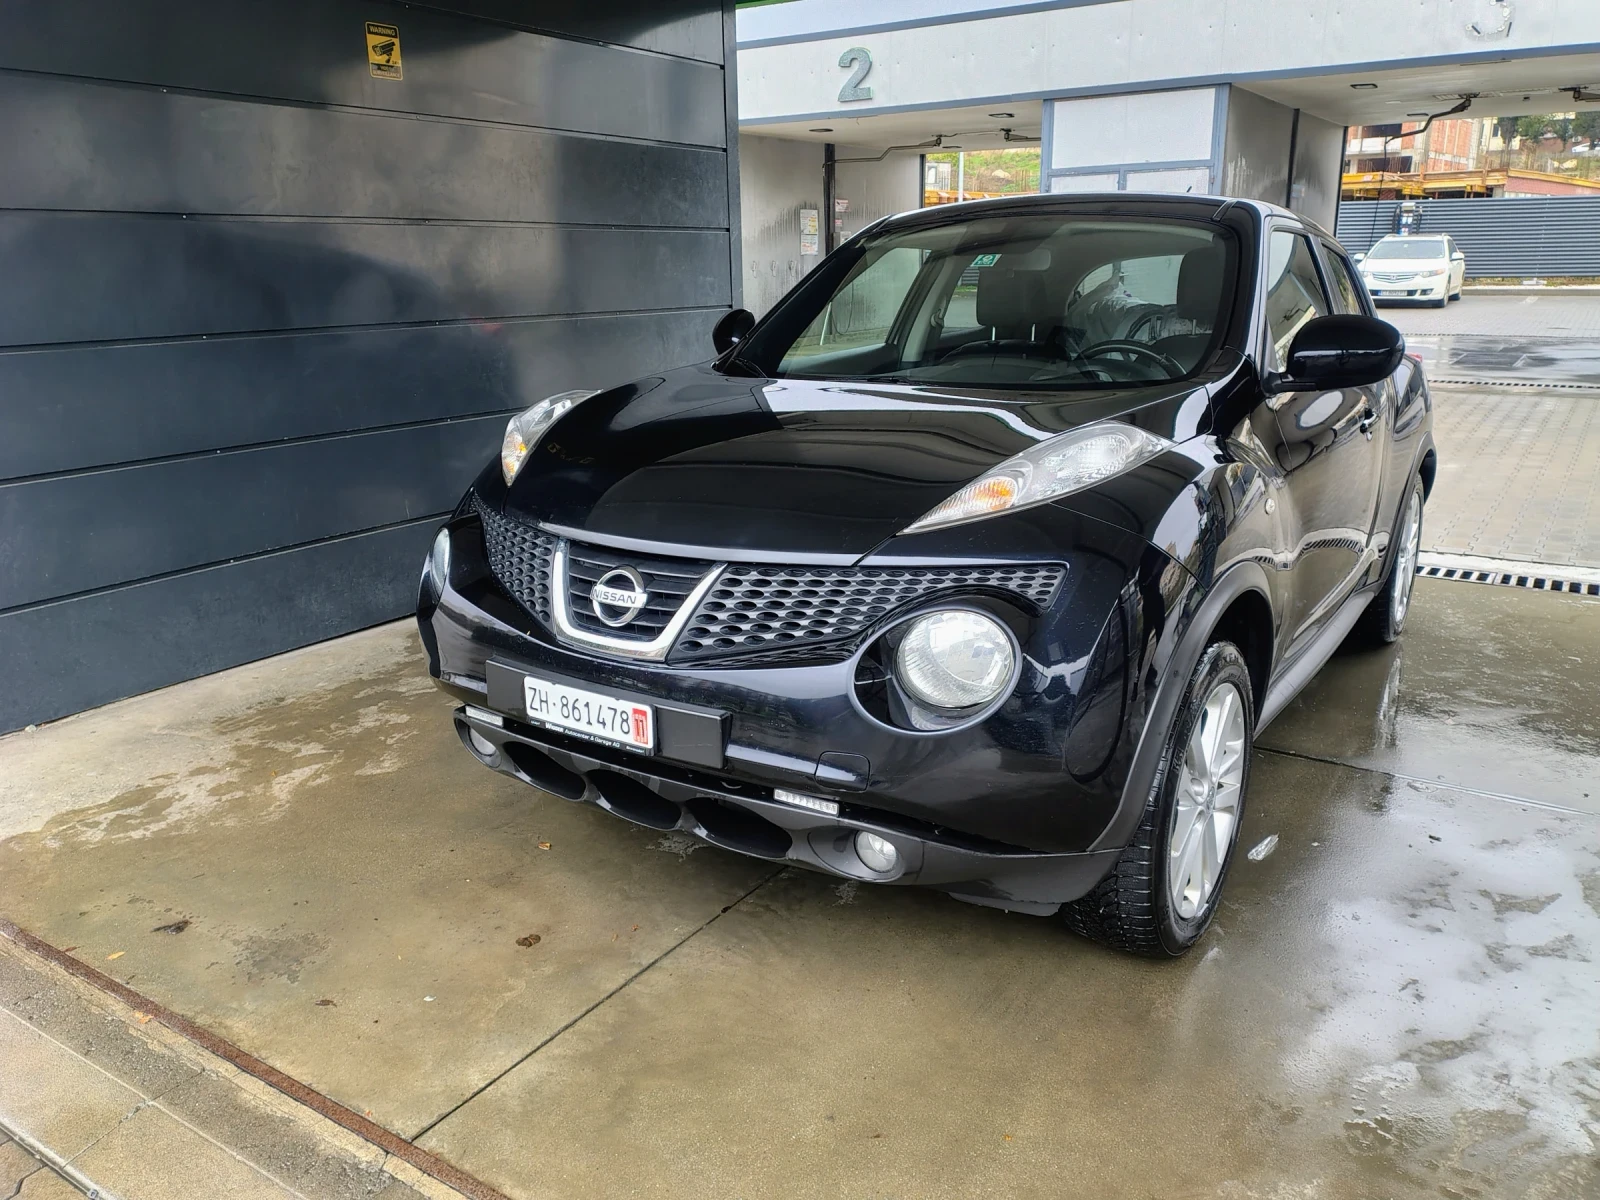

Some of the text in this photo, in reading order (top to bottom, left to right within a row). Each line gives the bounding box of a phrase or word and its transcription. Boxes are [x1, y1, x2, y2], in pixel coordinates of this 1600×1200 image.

[369, 26, 396, 36] WARNING
[837, 46, 873, 103] 2
[592, 588, 637, 605] NISSAN
[594, 736, 612, 747] Garage
